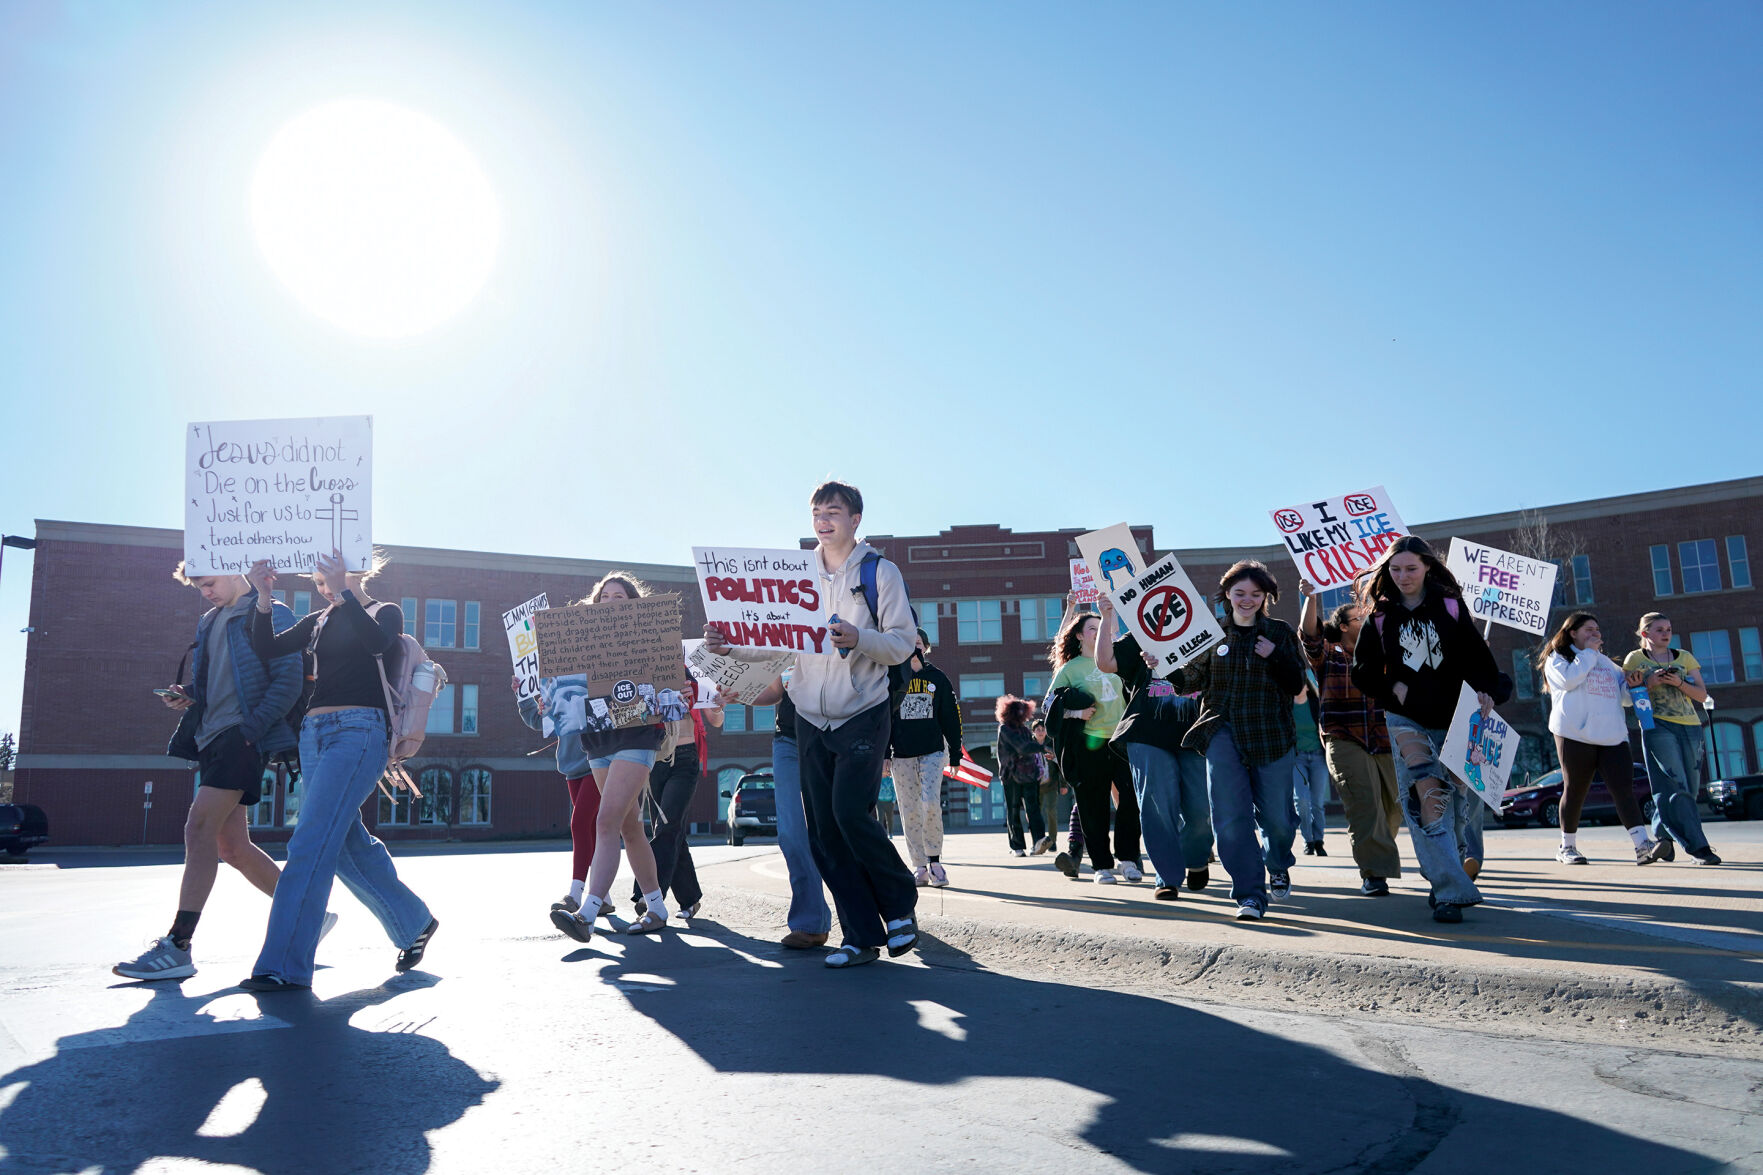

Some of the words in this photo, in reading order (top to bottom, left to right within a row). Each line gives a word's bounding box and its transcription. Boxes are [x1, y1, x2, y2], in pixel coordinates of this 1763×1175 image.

[199, 425, 279, 469] Jesus
[282, 436, 309, 463] did
[313, 438, 346, 463] not
[205, 471, 236, 494] Die
[245, 477, 268, 494] on
[275, 472, 305, 492] the
[310, 466, 357, 491] Cross
[207, 498, 241, 523] Just
[244, 501, 268, 523] for
[273, 505, 293, 521] us
[296, 504, 312, 520] to
[1312, 502, 1337, 523] I
[1346, 497, 1374, 513] ICE
[1277, 513, 1299, 529] ICE
[209, 526, 245, 546] treat
[247, 531, 283, 545] others
[285, 531, 313, 545] how
[1284, 529, 1329, 554] LIKE
[1324, 522, 1352, 546] MY
[1350, 513, 1395, 538] ICE
[209, 551, 242, 572] they
[699, 552, 738, 574] this
[772, 559, 809, 572] about
[1464, 546, 1490, 564] WE
[1119, 588, 1137, 605] NO
[1138, 561, 1175, 590] HUMAN
[1478, 564, 1520, 590] FREE
[705, 576, 820, 612] POLITICS
[1497, 590, 1540, 611] OTHERS
[620, 603, 633, 612] are
[637, 599, 677, 611] happening
[1144, 593, 1186, 634] ICE
[1473, 597, 1546, 630] OPPRESSED
[580, 616, 598, 625] Poor
[637, 611, 662, 622] people
[664, 609, 678, 617] are
[766, 612, 791, 621] about
[538, 630, 561, 639] being
[565, 626, 600, 636] dragged
[602, 623, 617, 631] out
[633, 620, 653, 629] their
[600, 641, 614, 649] are
[606, 650, 628, 658] home
[1165, 653, 1179, 665] IS
[1179, 629, 1212, 656] ILLEGAL
[576, 661, 595, 670] that
[599, 659, 620, 668] their
[624, 656, 656, 666] parents
[660, 652, 682, 661] have
[655, 663, 677, 672] Anne
[618, 683, 631, 692] ICE
[652, 673, 677, 682] Frank
[617, 691, 633, 699] OUT
[1482, 735, 1503, 768] ICE
